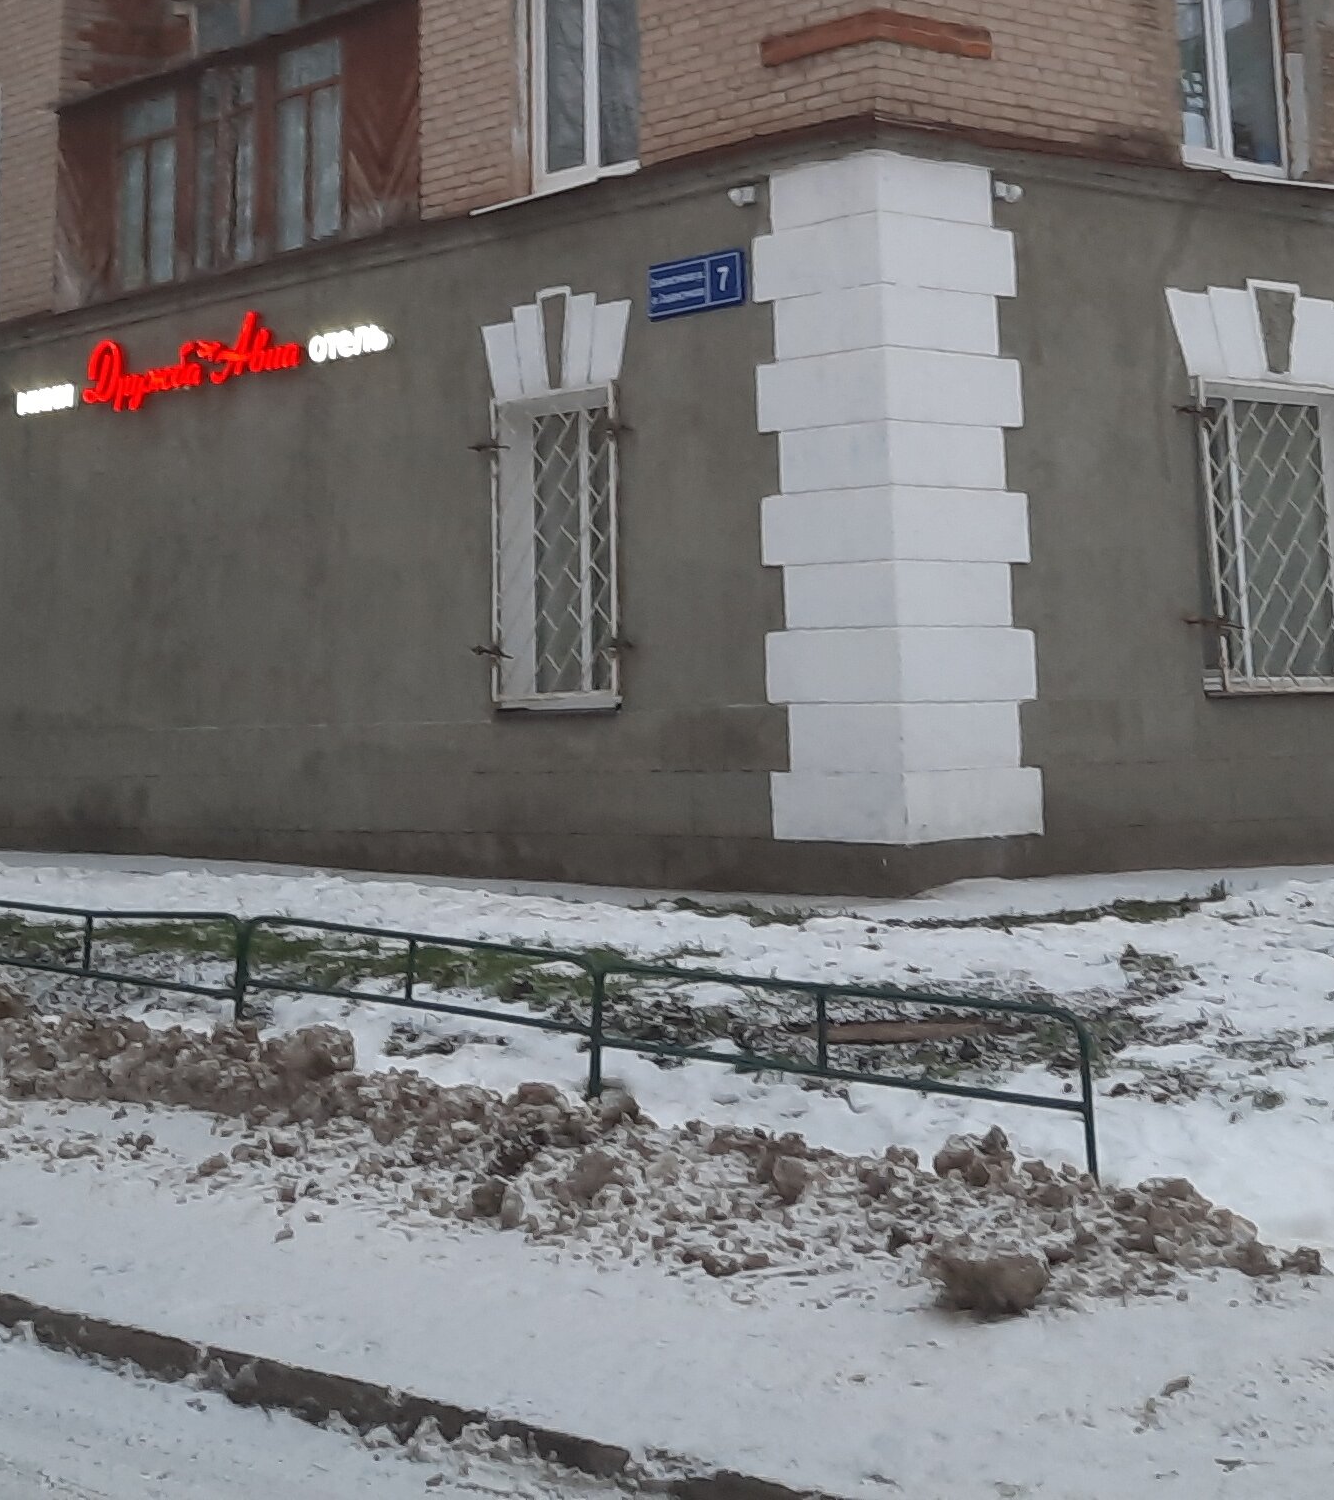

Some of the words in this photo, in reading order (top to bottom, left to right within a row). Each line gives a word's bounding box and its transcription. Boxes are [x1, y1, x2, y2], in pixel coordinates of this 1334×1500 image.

[715, 265, 730, 292] 7
[209, 310, 301, 385] Авиа
[308, 324, 389, 363] отель
